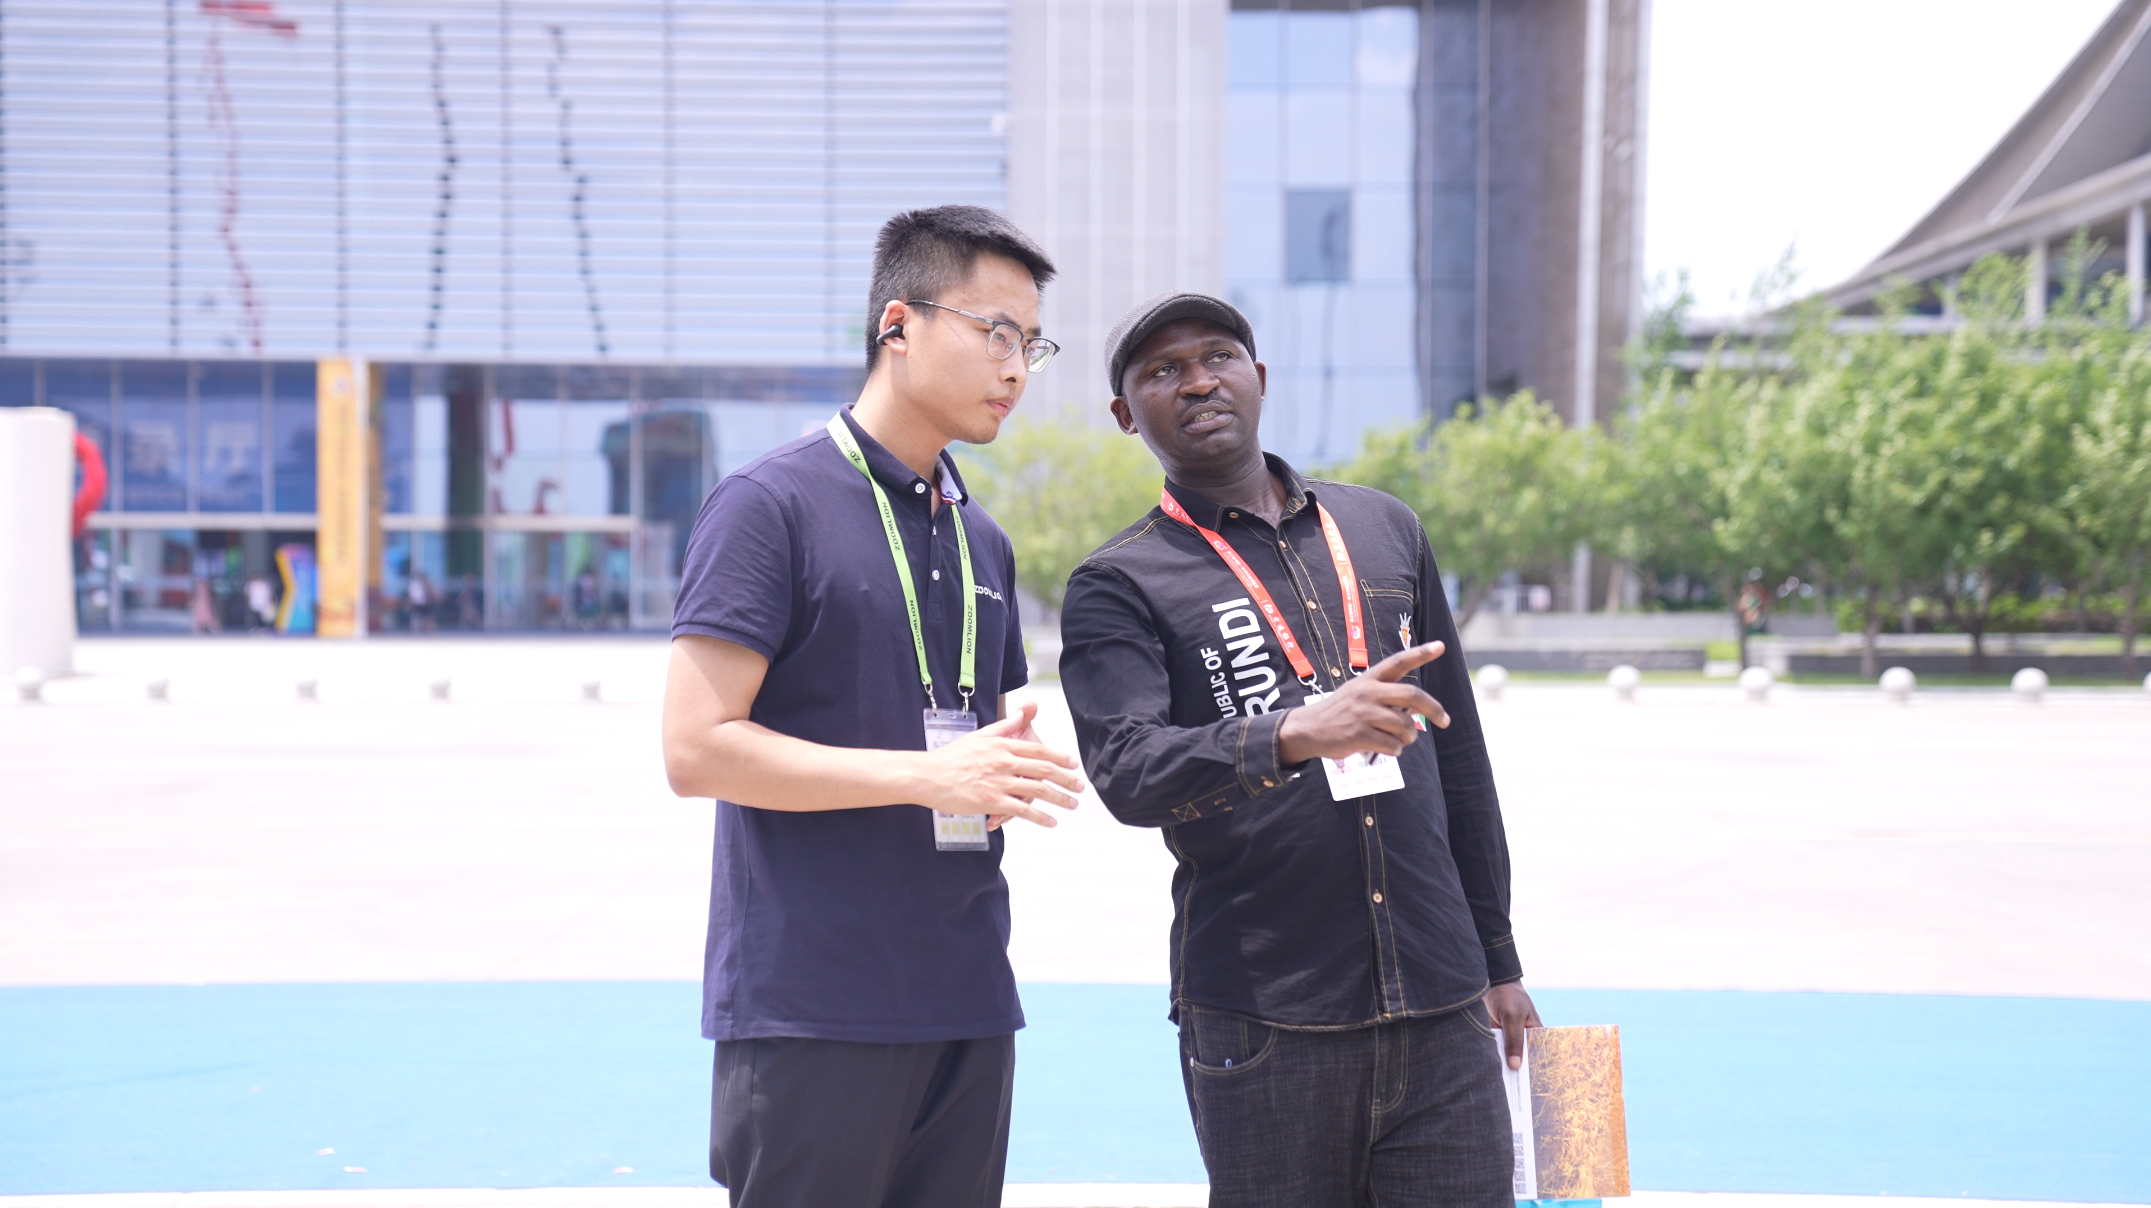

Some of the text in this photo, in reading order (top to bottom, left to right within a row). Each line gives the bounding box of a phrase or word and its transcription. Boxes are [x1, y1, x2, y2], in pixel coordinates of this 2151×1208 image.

[881, 501, 901, 552] ZOOMLION
[955, 515, 968, 560] ZOOMLION
[909, 600, 923, 652] ZOOMLION
[966, 604, 974, 655] ZOOMLION
[1200, 647, 1238, 718] UBLIC OF
[1212, 597, 1284, 717] RUNDI
